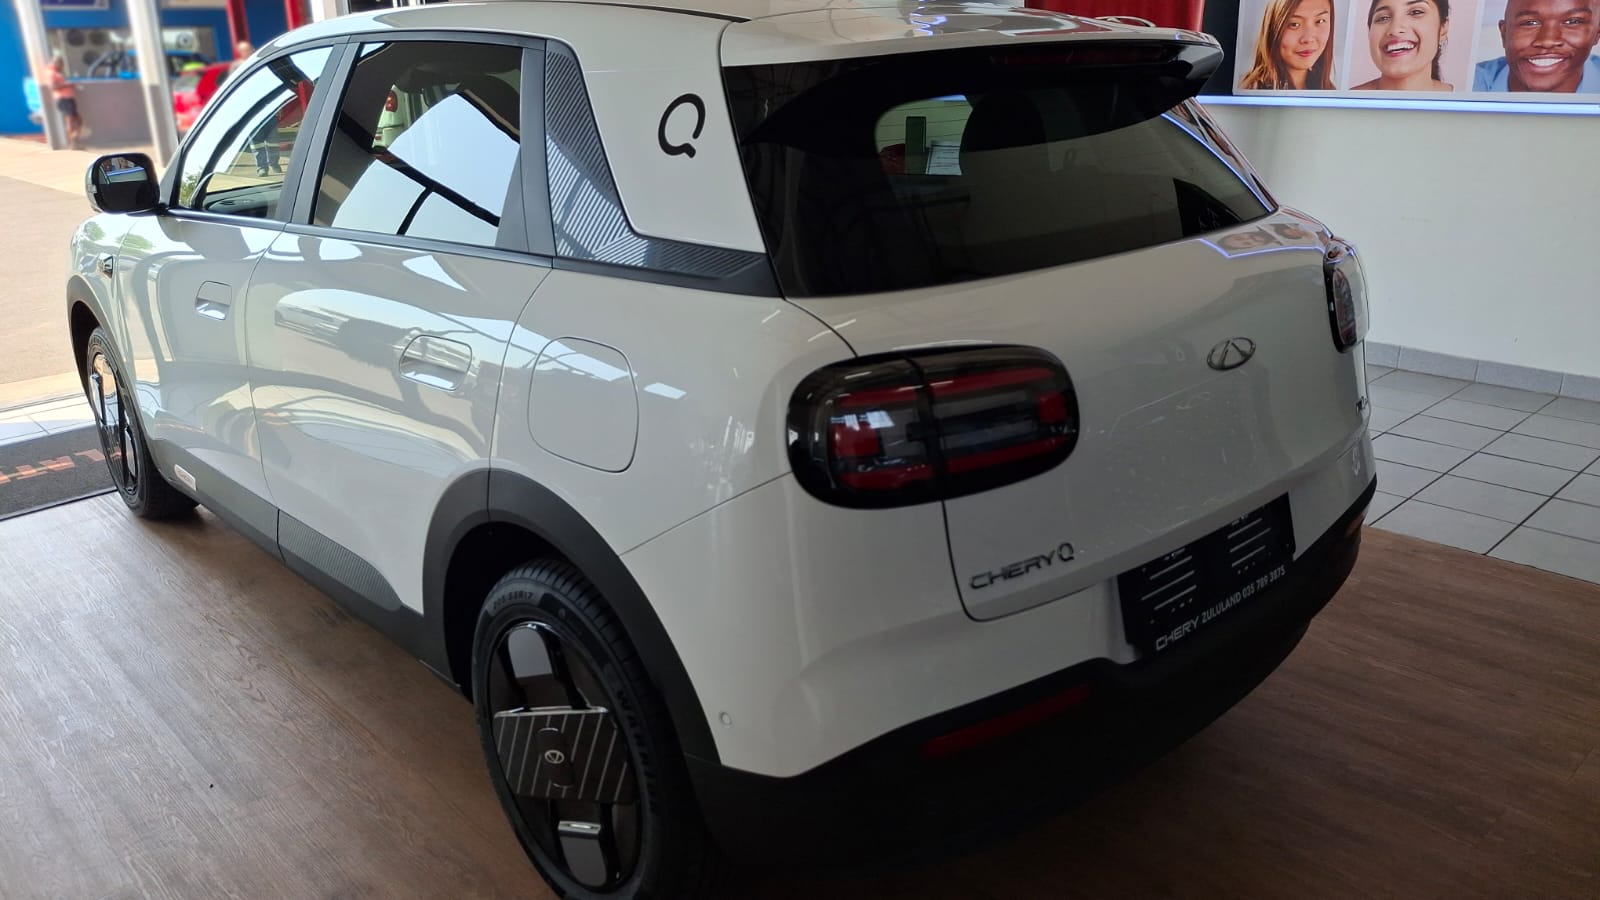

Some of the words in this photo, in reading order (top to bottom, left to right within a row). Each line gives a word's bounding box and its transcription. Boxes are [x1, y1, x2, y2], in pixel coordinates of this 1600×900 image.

[1155, 616, 1199, 651] CHERY
[1201, 591, 1242, 624] ZULULAND
[1242, 581, 1256, 599] 035
[1256, 575, 1268, 590] 789
[1269, 564, 1285, 583] 3875
